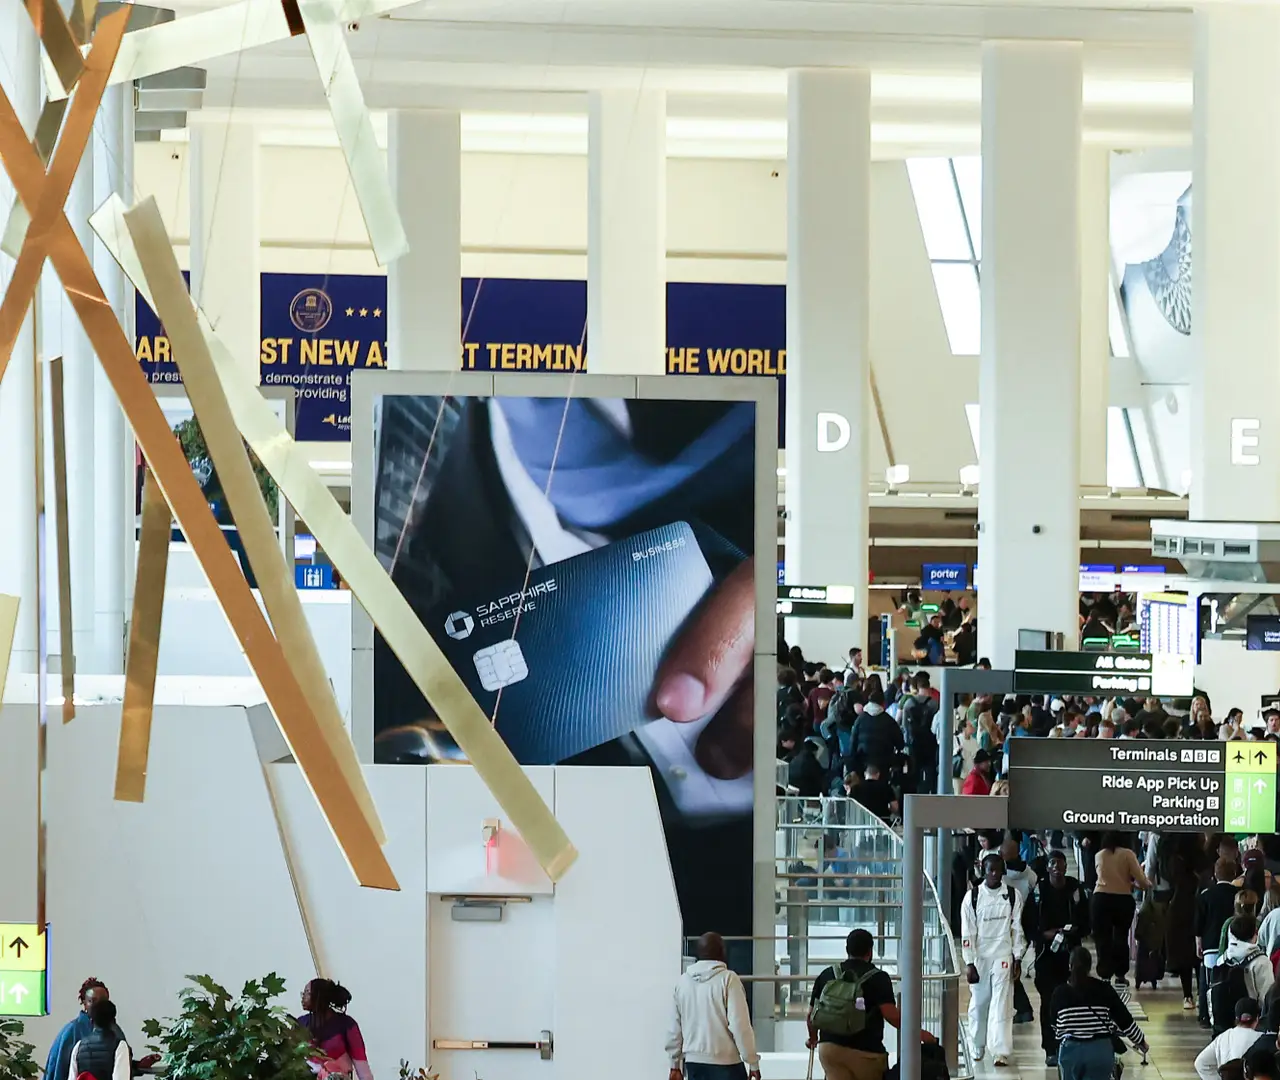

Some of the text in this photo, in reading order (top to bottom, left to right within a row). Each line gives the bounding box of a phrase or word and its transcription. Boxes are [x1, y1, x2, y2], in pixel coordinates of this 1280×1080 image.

[301, 339, 360, 366] NEW
[486, 343, 587, 371] TERMIN
[665, 347, 700, 373] HE
[265, 372, 343, 386] demonstrate
[815, 411, 852, 454] D
[1231, 417, 1262, 466] E
[631, 537, 686, 562] BUSINESS
[930, 569, 959, 580] porter
[475, 578, 558, 617] SAPPHIRE
[480, 600, 537, 628] RESERVE
[1109, 747, 1178, 762] Terminals
[1102, 775, 1219, 792] Ride App Pick Up
[1152, 795, 1204, 811] Parking
[1063, 810, 1219, 827] Ground Transportation
